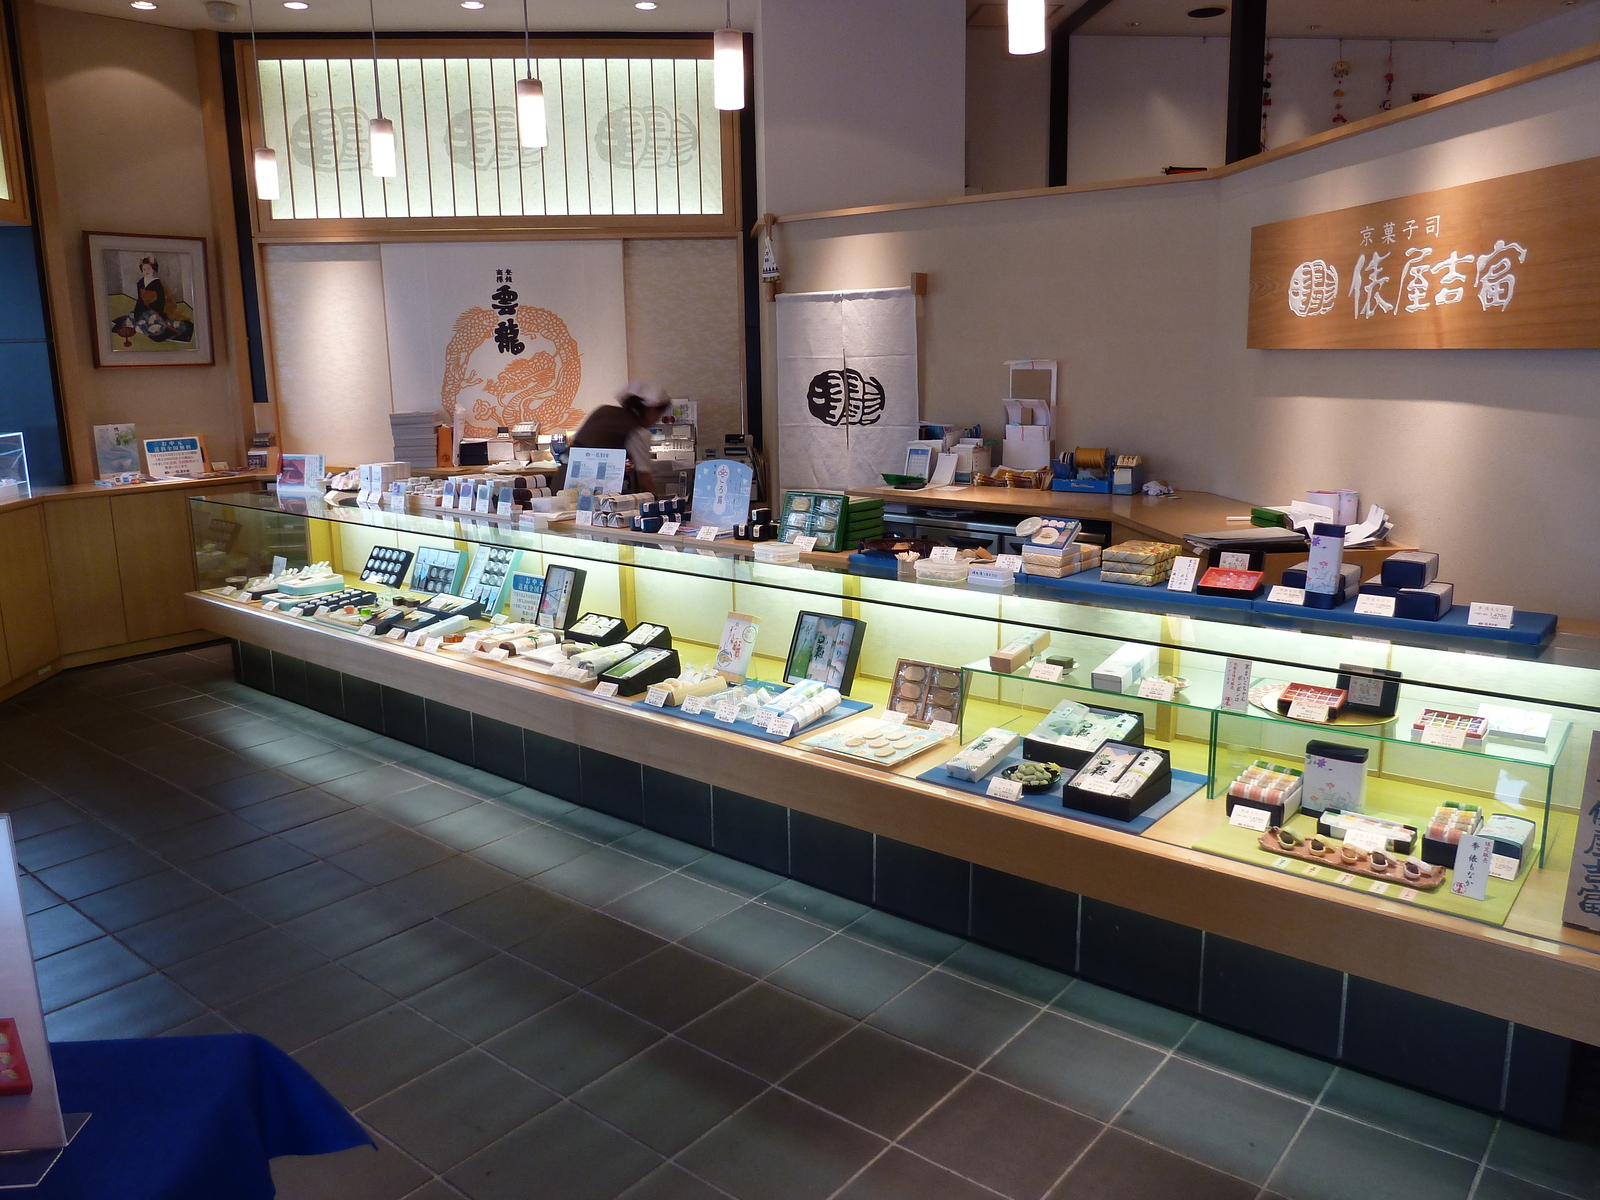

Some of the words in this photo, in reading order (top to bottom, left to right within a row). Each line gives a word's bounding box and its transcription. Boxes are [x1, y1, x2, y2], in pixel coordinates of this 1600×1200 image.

[1360, 215, 1441, 246] 京菓子司
[1348, 239, 1528, 320] 俵屋吉富
[492, 285, 525, 355] 雲龍
[1482, 841, 1491, 864] 限定販売
